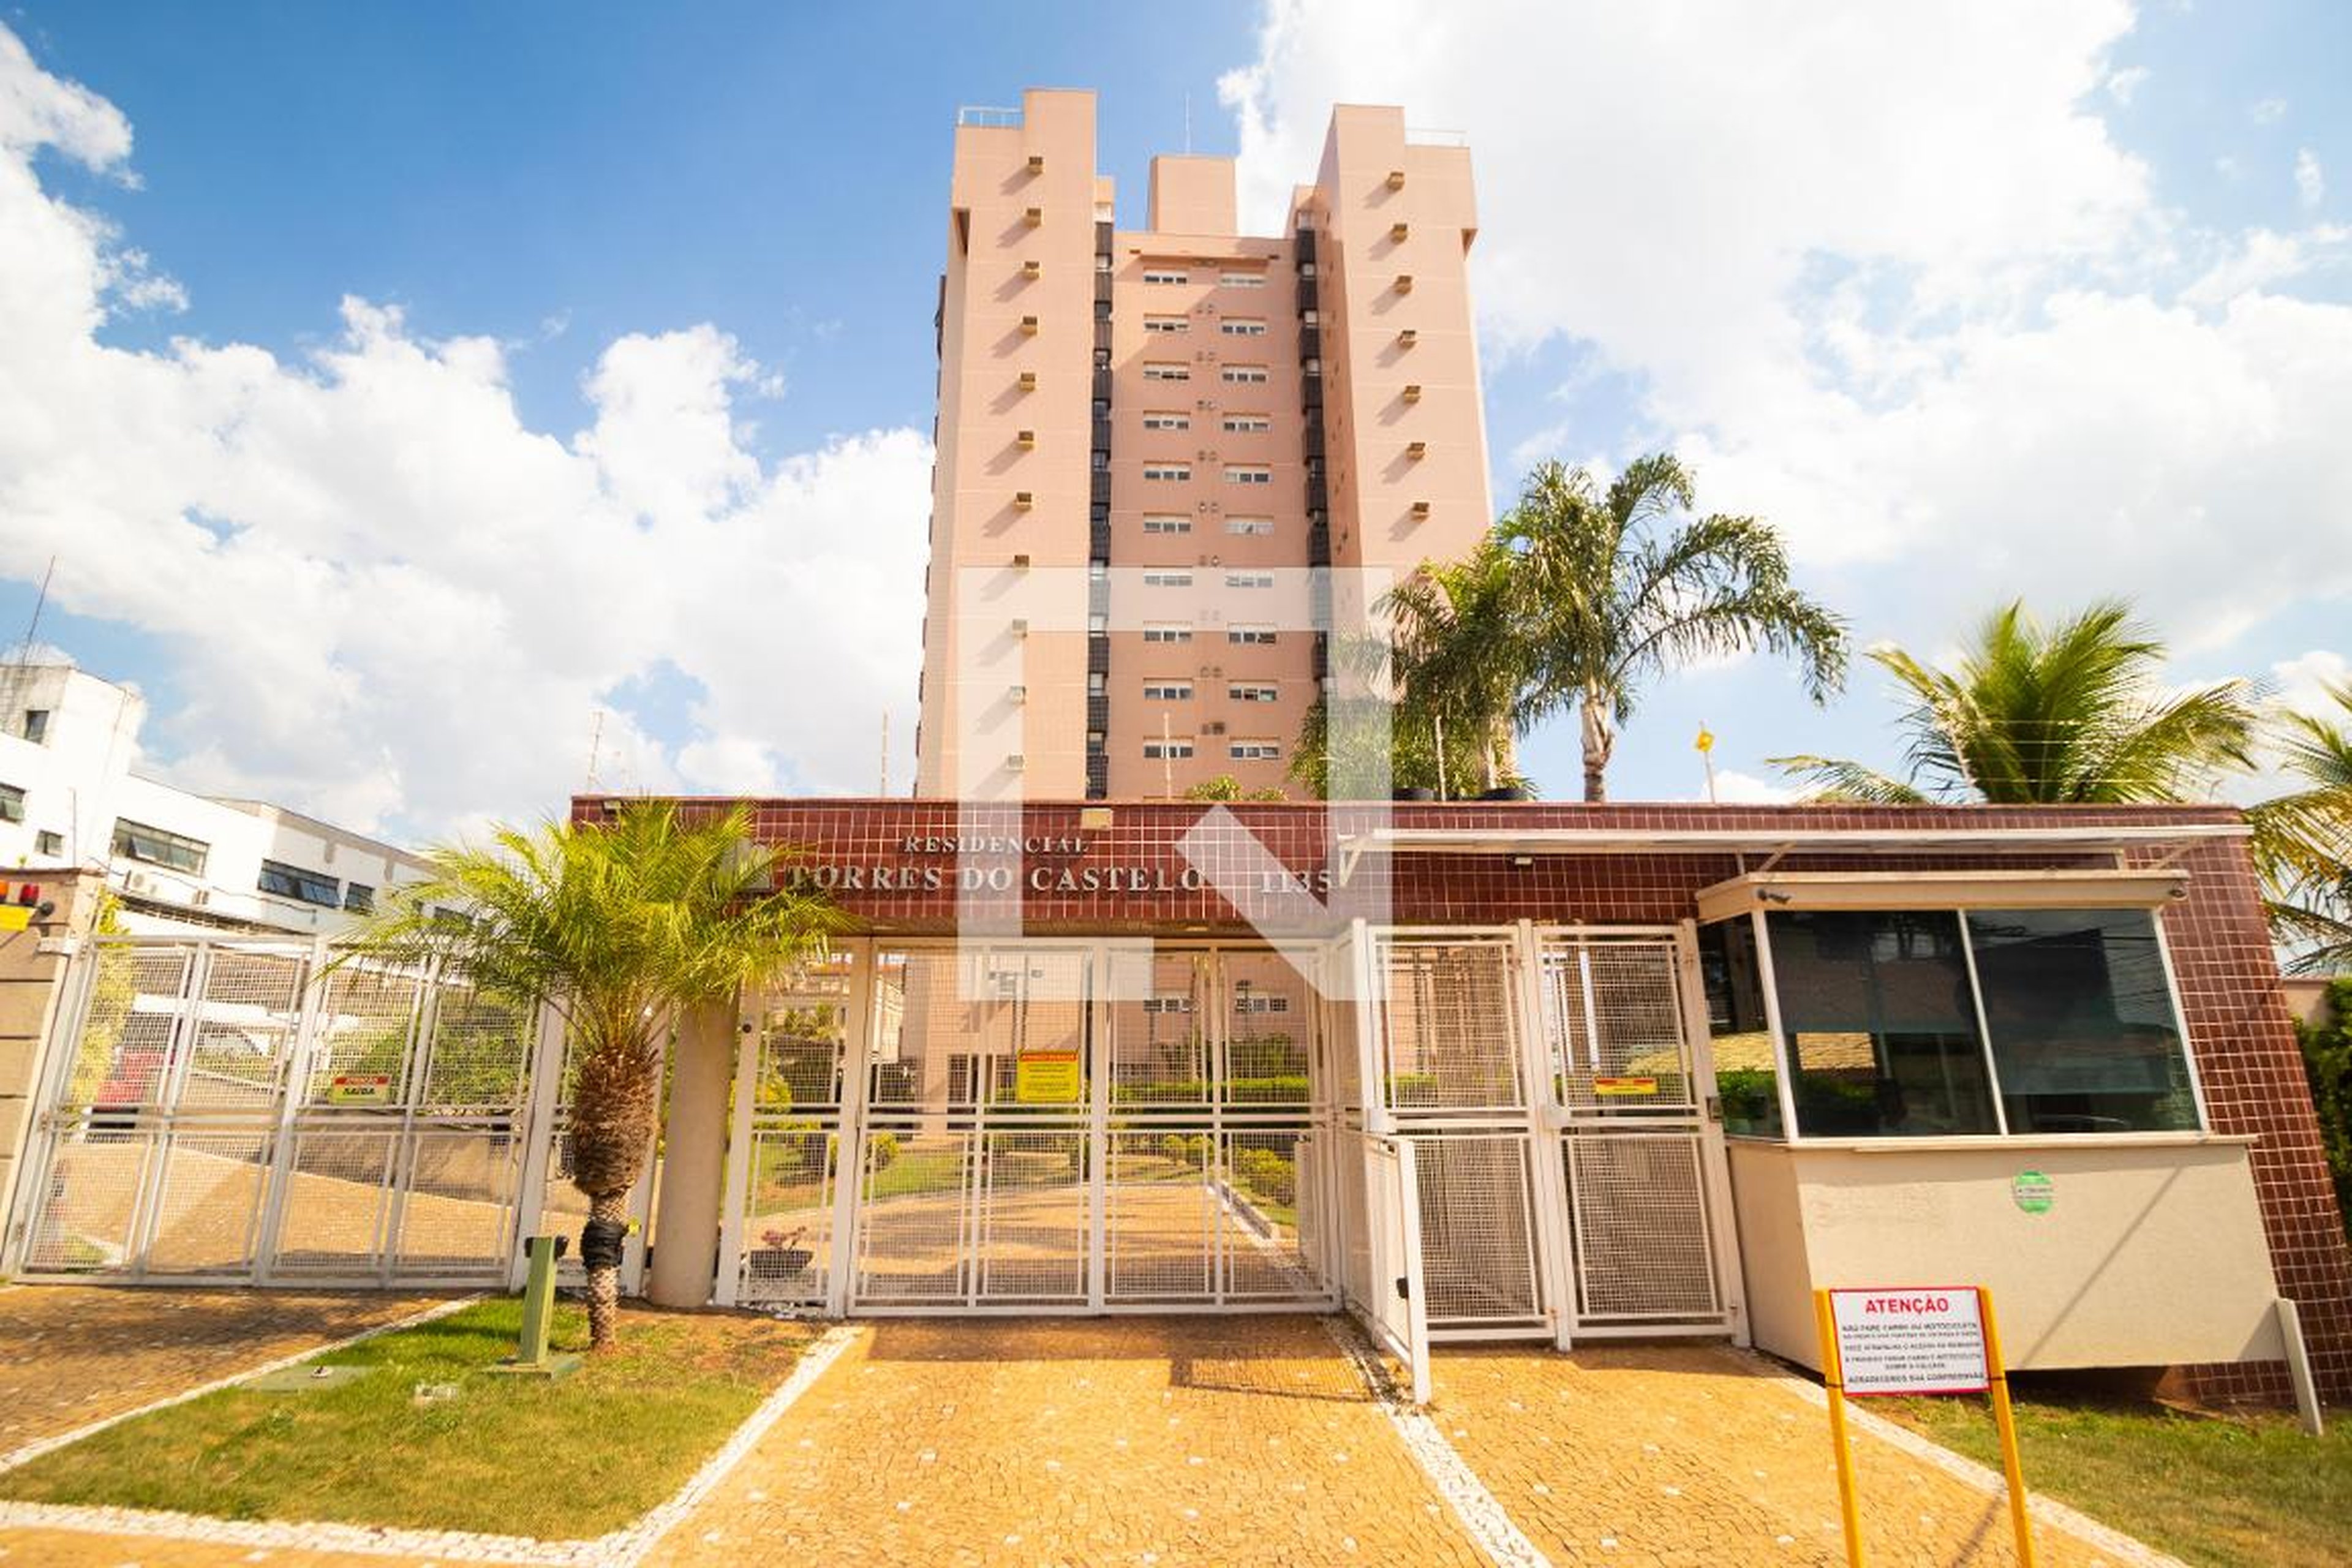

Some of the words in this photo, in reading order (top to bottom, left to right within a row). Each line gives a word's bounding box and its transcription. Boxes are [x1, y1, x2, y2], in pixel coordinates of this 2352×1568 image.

[903, 835, 1089, 853] RESIDENCIAL
[788, 865, 943, 890] TORRES
[962, 866, 1012, 891] DO
[1030, 867, 1206, 892] CASTELO
[1260, 869, 1333, 894] 1135
[1865, 1294, 1949, 1314] ATENÇÃO
